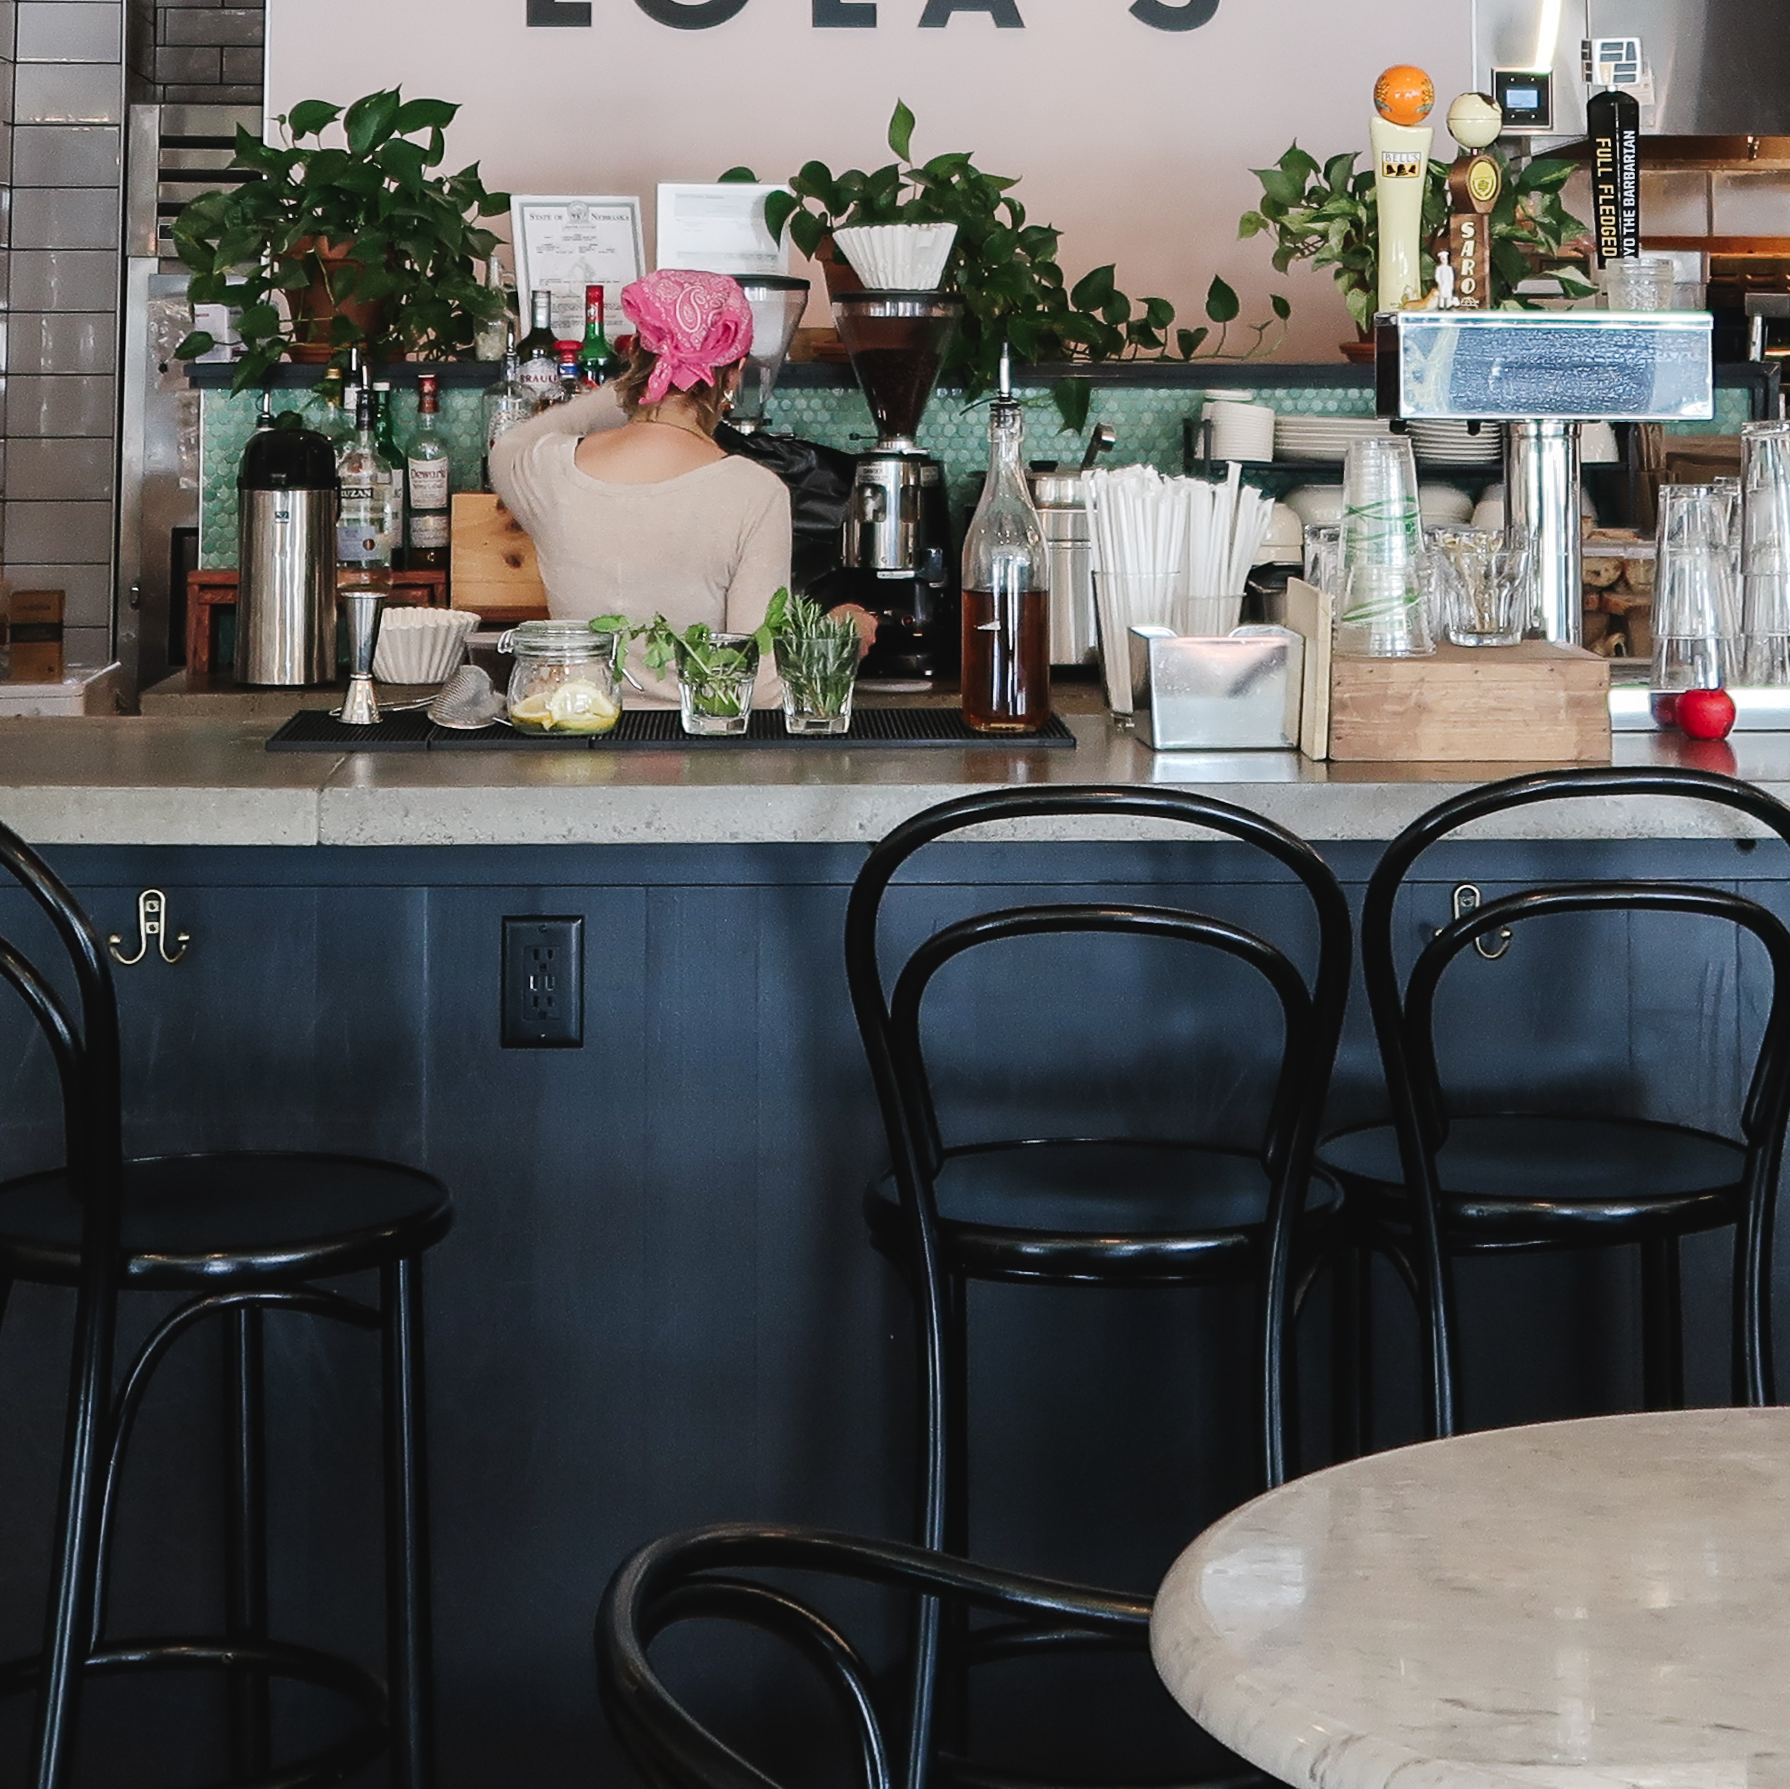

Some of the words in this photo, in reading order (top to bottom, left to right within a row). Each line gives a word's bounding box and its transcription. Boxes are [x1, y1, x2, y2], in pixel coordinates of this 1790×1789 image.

[1595, 137, 1613, 178] FULL
[1622, 130, 1636, 207] BARBARIAN
[1598, 184, 1618, 257] FLEDGED
[1622, 209, 1636, 236] THE
[1460, 221, 1476, 295] SARO
